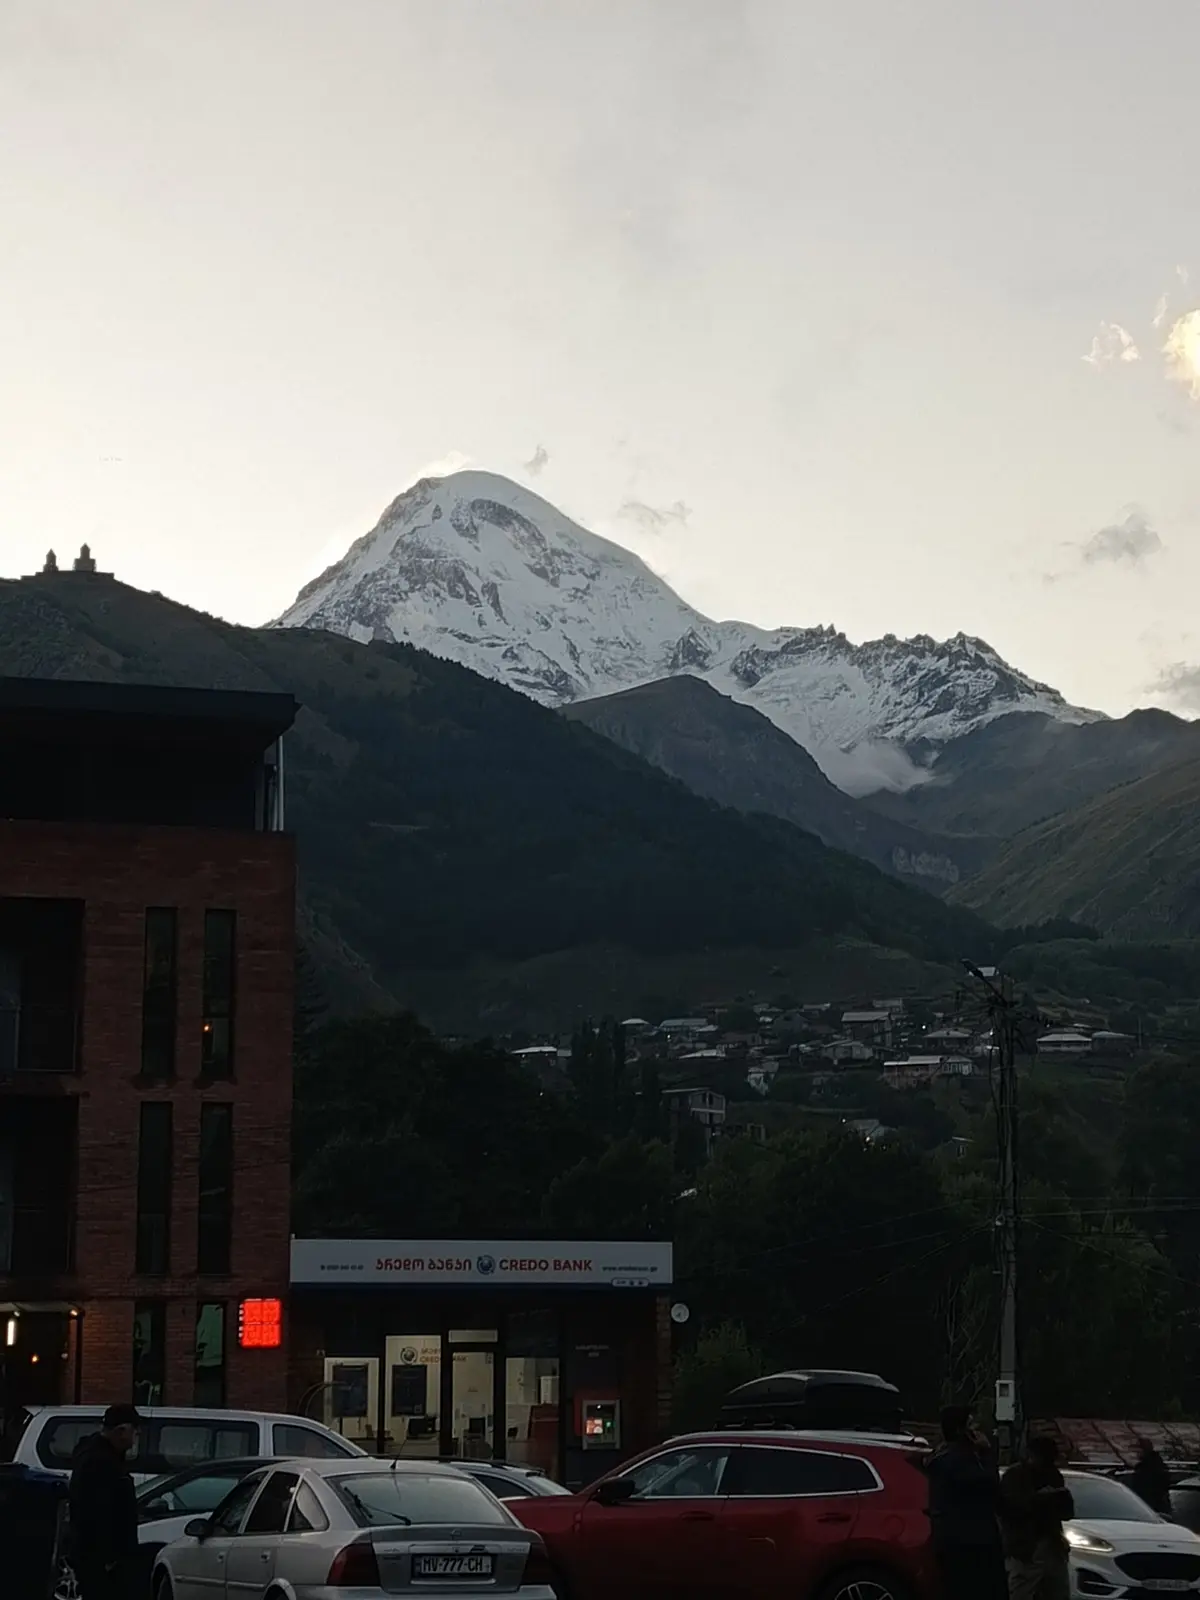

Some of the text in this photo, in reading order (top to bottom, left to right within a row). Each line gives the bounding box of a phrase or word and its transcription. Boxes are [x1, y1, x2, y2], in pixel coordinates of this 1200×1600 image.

[499, 1259, 549, 1272] CREDO
[553, 1259, 593, 1272] BANK
[423, 1557, 483, 1572] MV-777-CH
